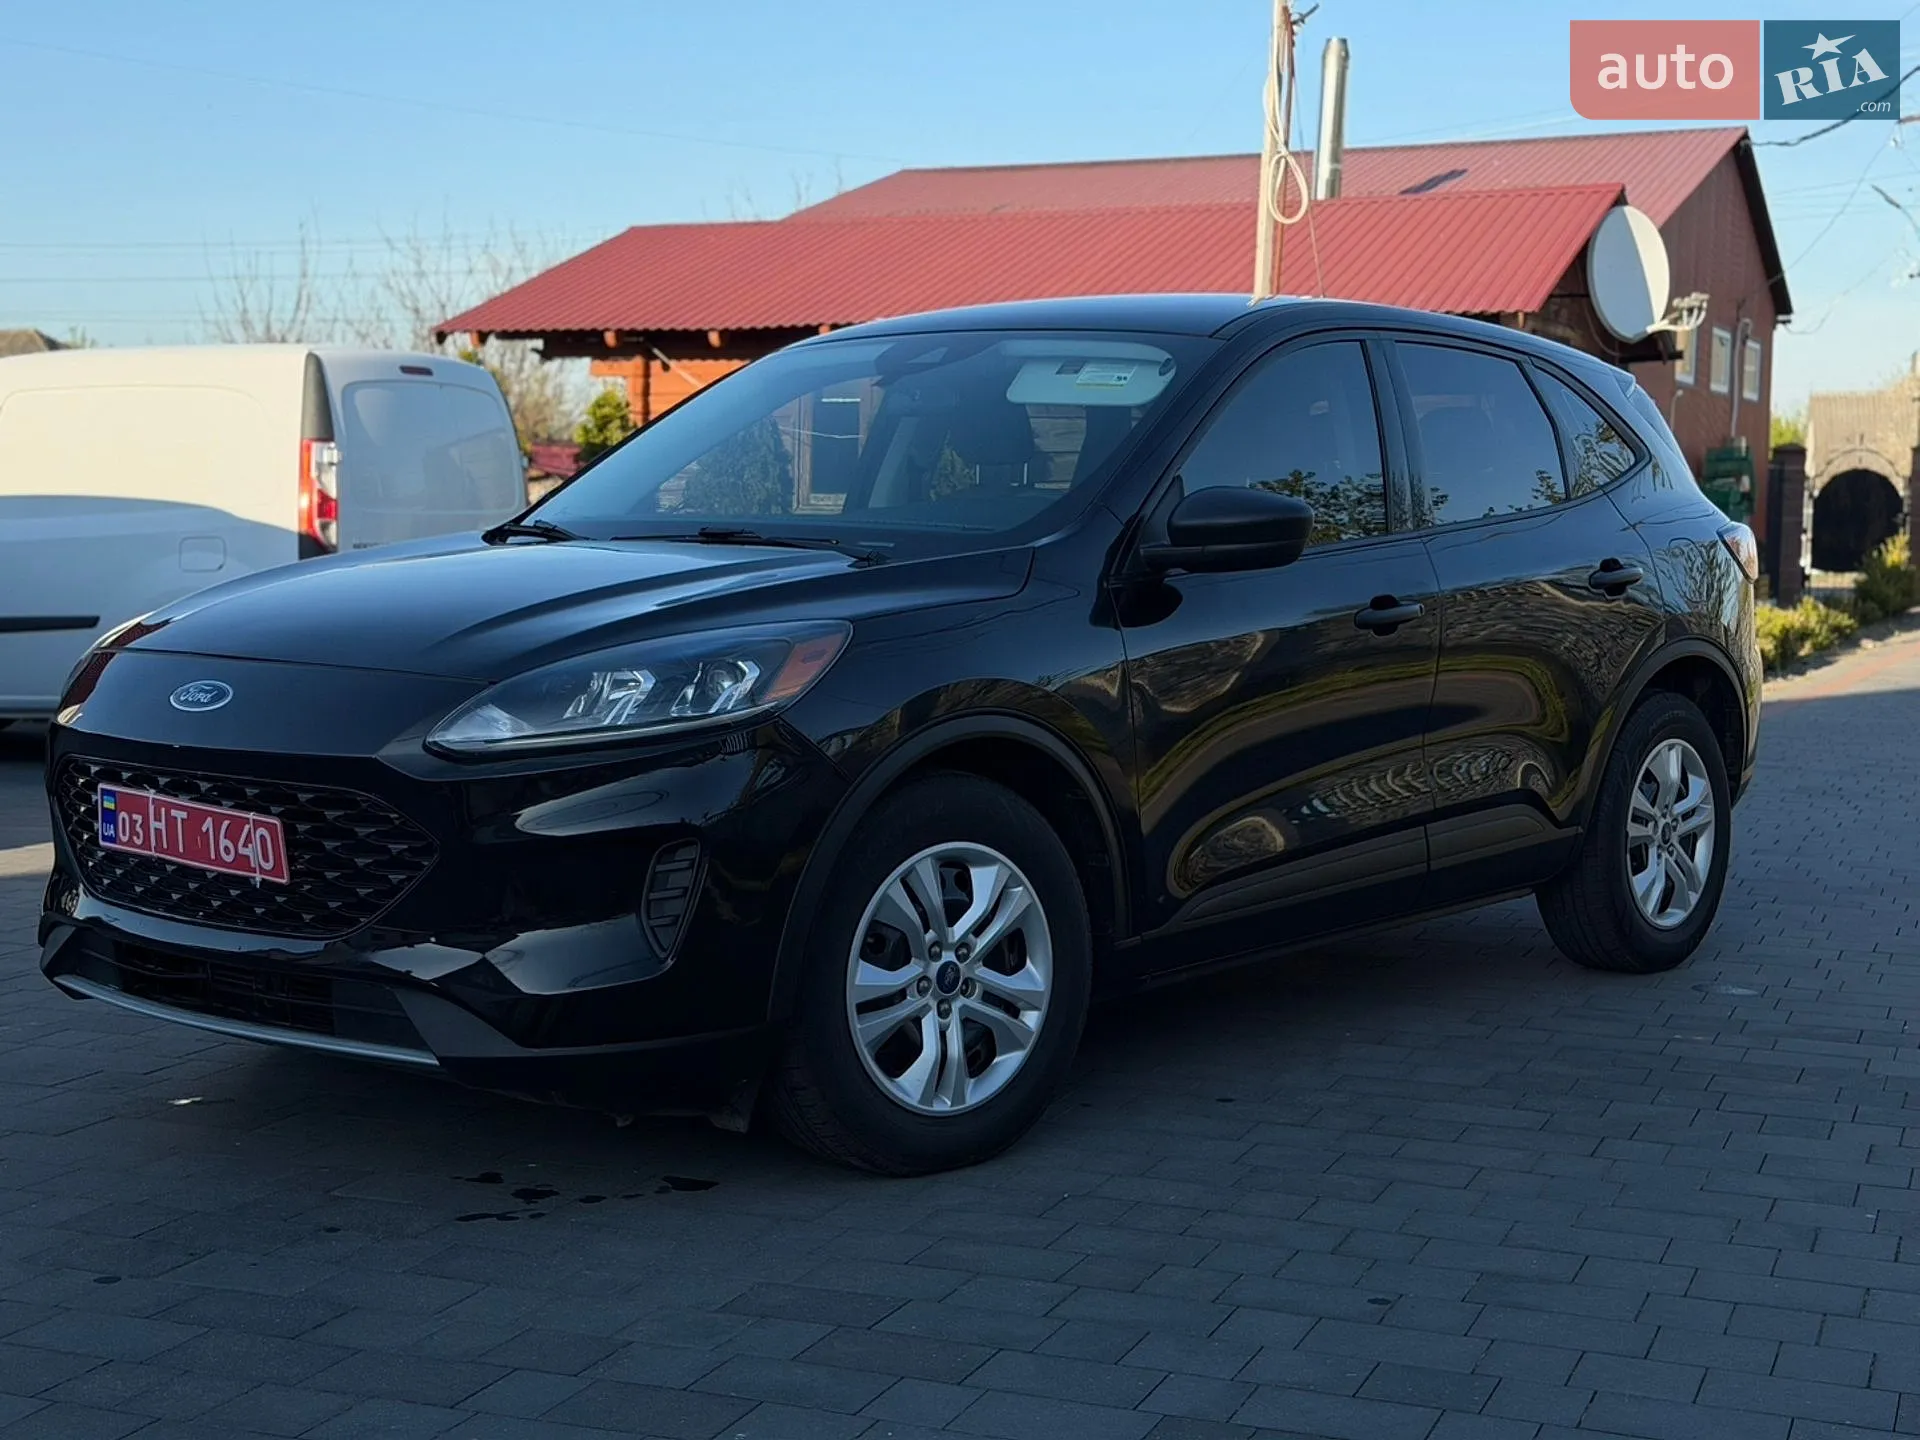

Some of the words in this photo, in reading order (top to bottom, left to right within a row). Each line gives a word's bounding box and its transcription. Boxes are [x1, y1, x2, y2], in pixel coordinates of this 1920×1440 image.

[180, 685, 218, 703] Ford
[102, 822, 115, 838] UA
[201, 816, 275, 871] 1640
